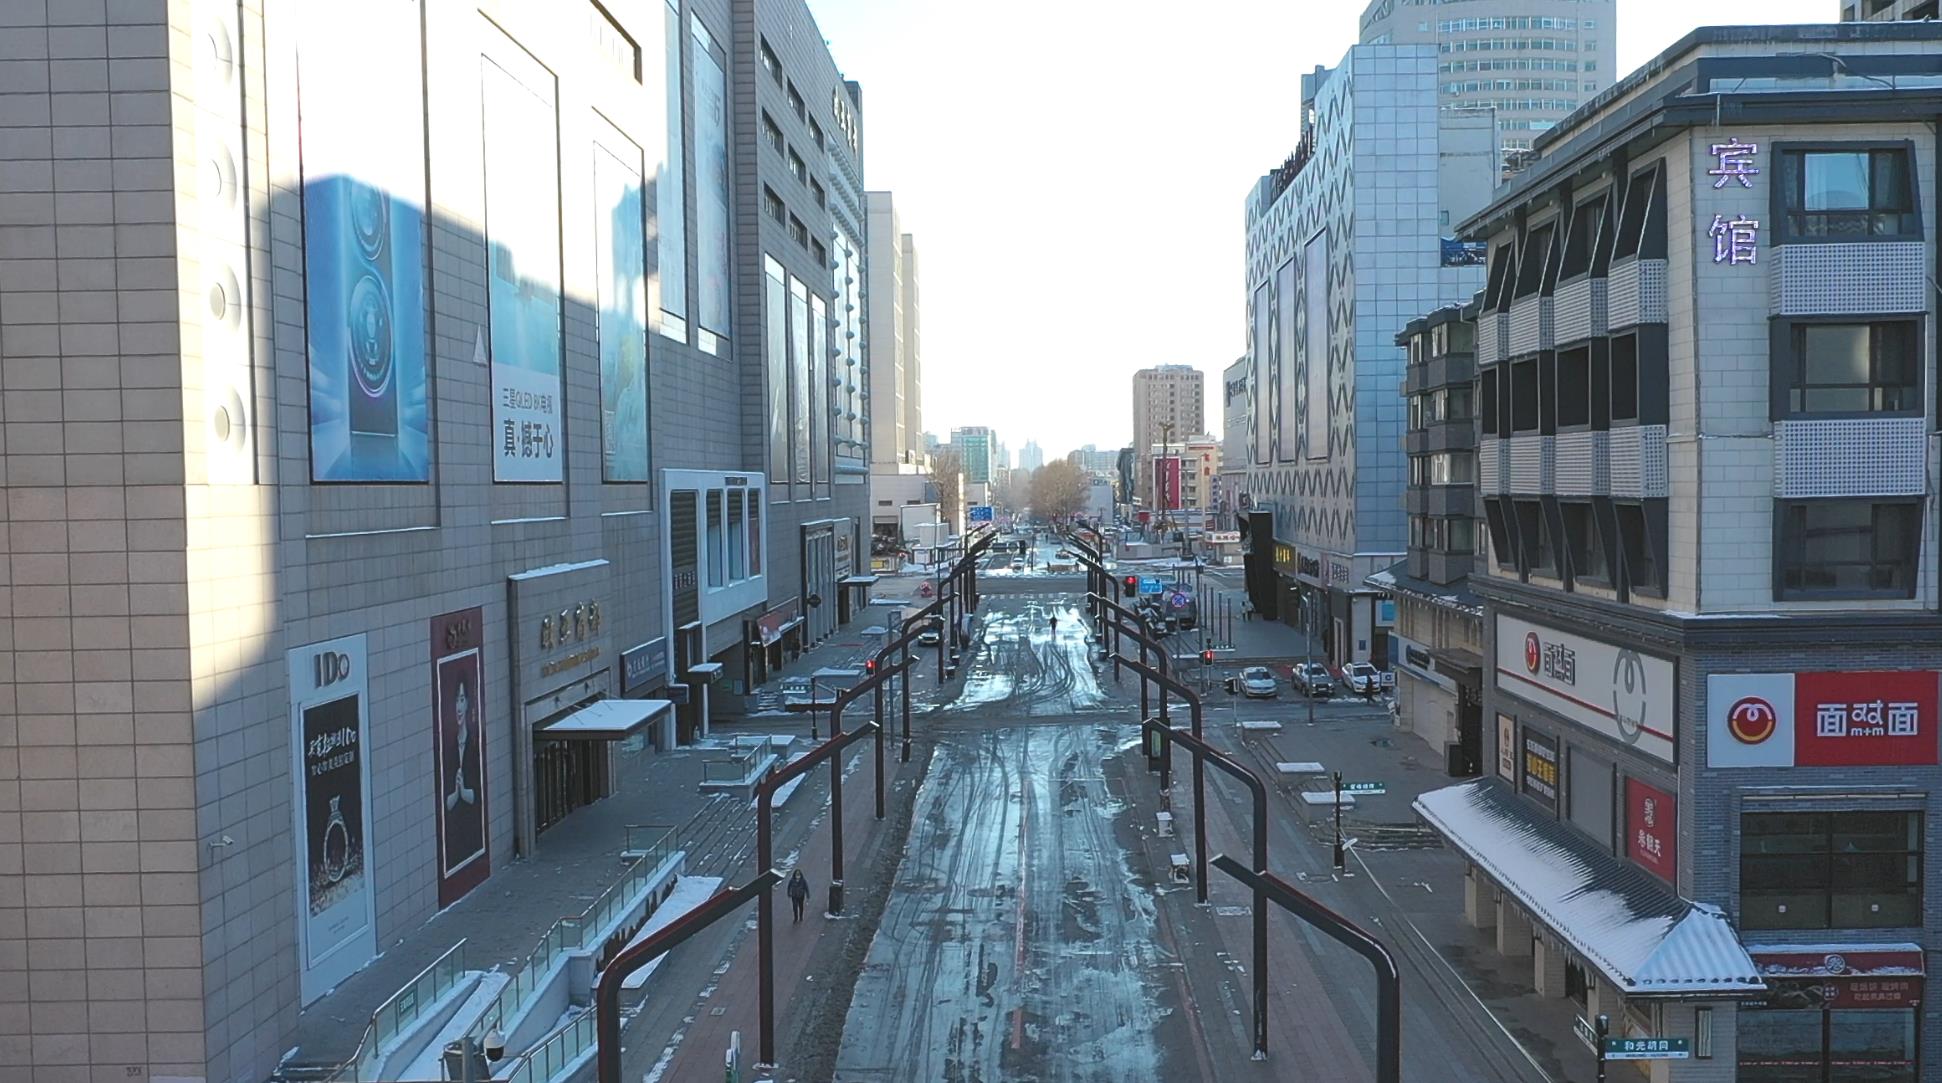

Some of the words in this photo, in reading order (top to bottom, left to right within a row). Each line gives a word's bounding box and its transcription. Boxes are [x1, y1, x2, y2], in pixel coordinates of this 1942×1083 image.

[1708, 137, 1760, 265] 宾馆
[1816, 699, 1919, 737] 面对面
[1850, 727, 1884, 737] m+m
